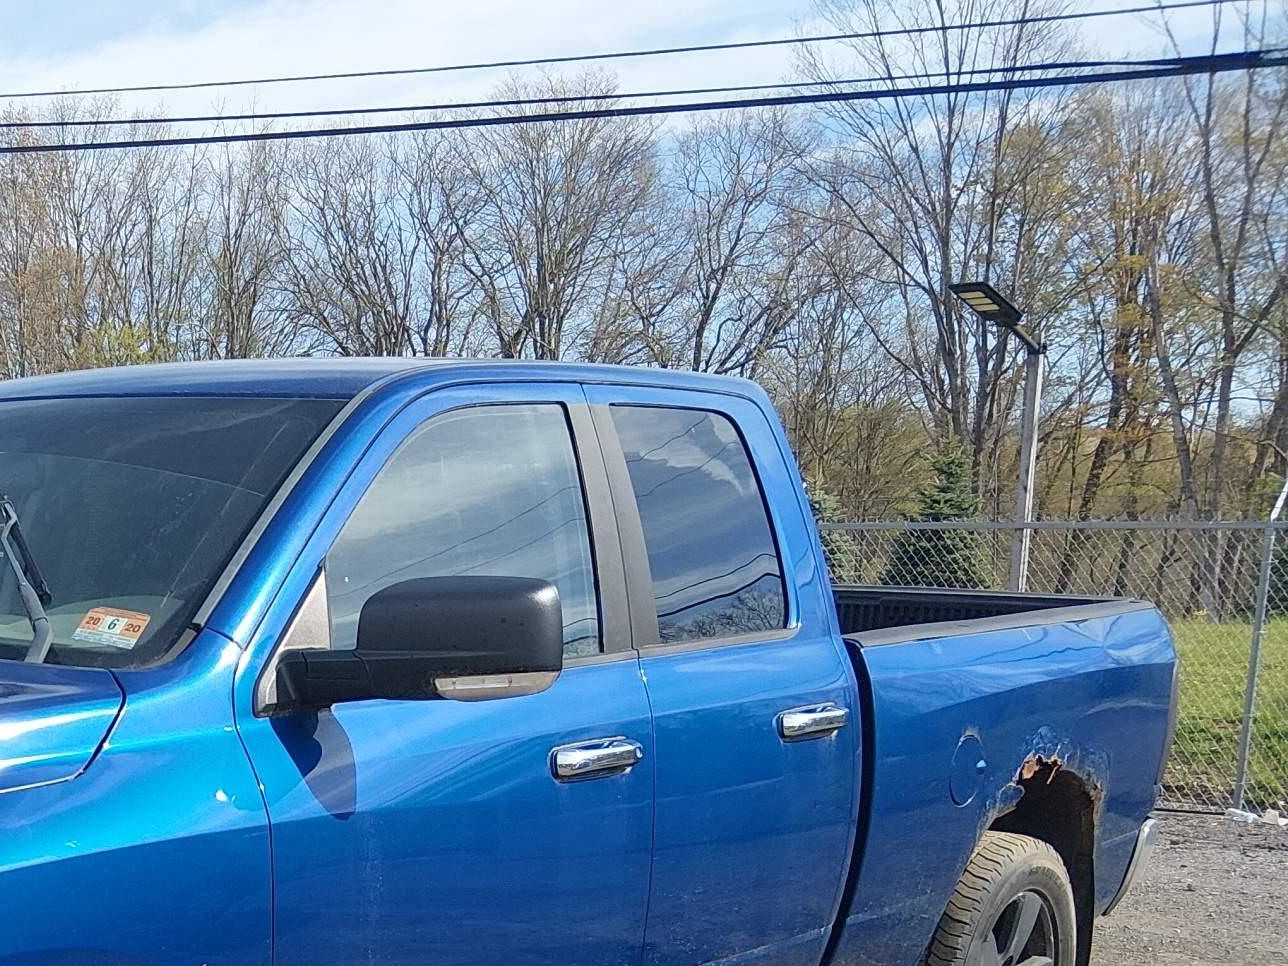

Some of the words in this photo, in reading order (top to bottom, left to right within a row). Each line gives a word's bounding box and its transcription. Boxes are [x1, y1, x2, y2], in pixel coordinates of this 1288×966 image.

[85, 616, 101, 626] 20
[107, 618, 120, 630] 6
[124, 623, 141, 633] 20
